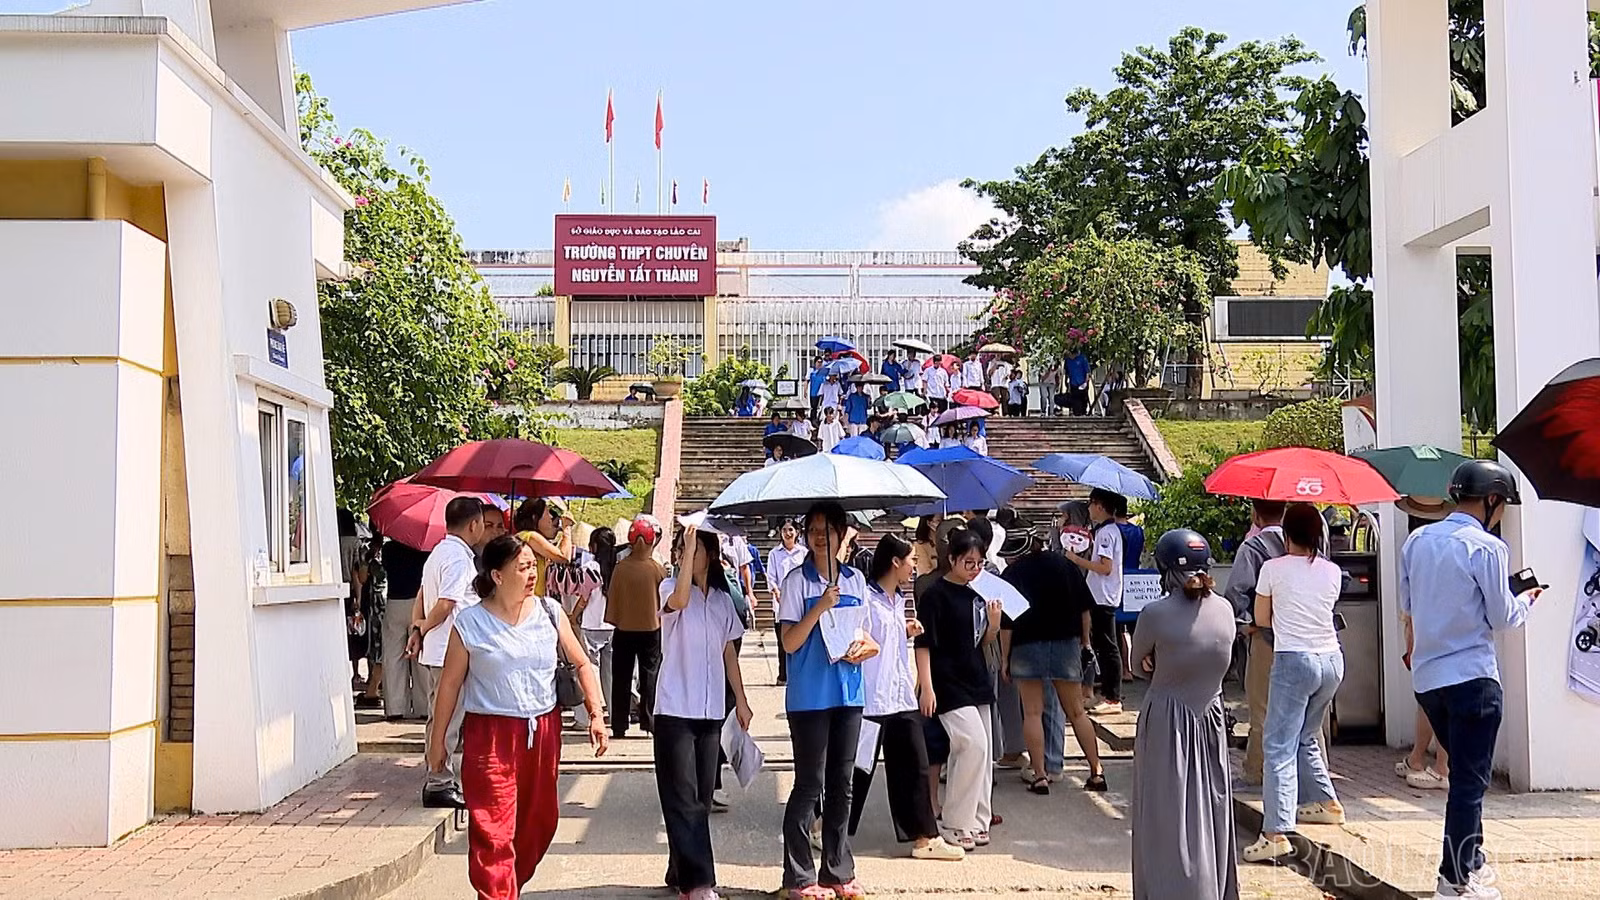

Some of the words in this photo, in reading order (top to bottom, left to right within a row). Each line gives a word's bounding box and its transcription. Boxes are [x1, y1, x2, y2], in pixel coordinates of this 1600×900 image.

[571, 226, 582, 235] SỞ
[583, 226, 603, 235] GIÁO
[605, 228, 621, 236] DỤC
[623, 226, 634, 235] VÀ
[670, 227, 685, 235] LÀO
[563, 243, 617, 260] TRƯỜNG
[619, 246, 653, 260] THPT
[655, 243, 708, 260] CHUYÊN
[571, 263, 626, 282] NGUYỄN
[629, 263, 652, 282] TẤT
[655, 265, 699, 282] THÀNH
